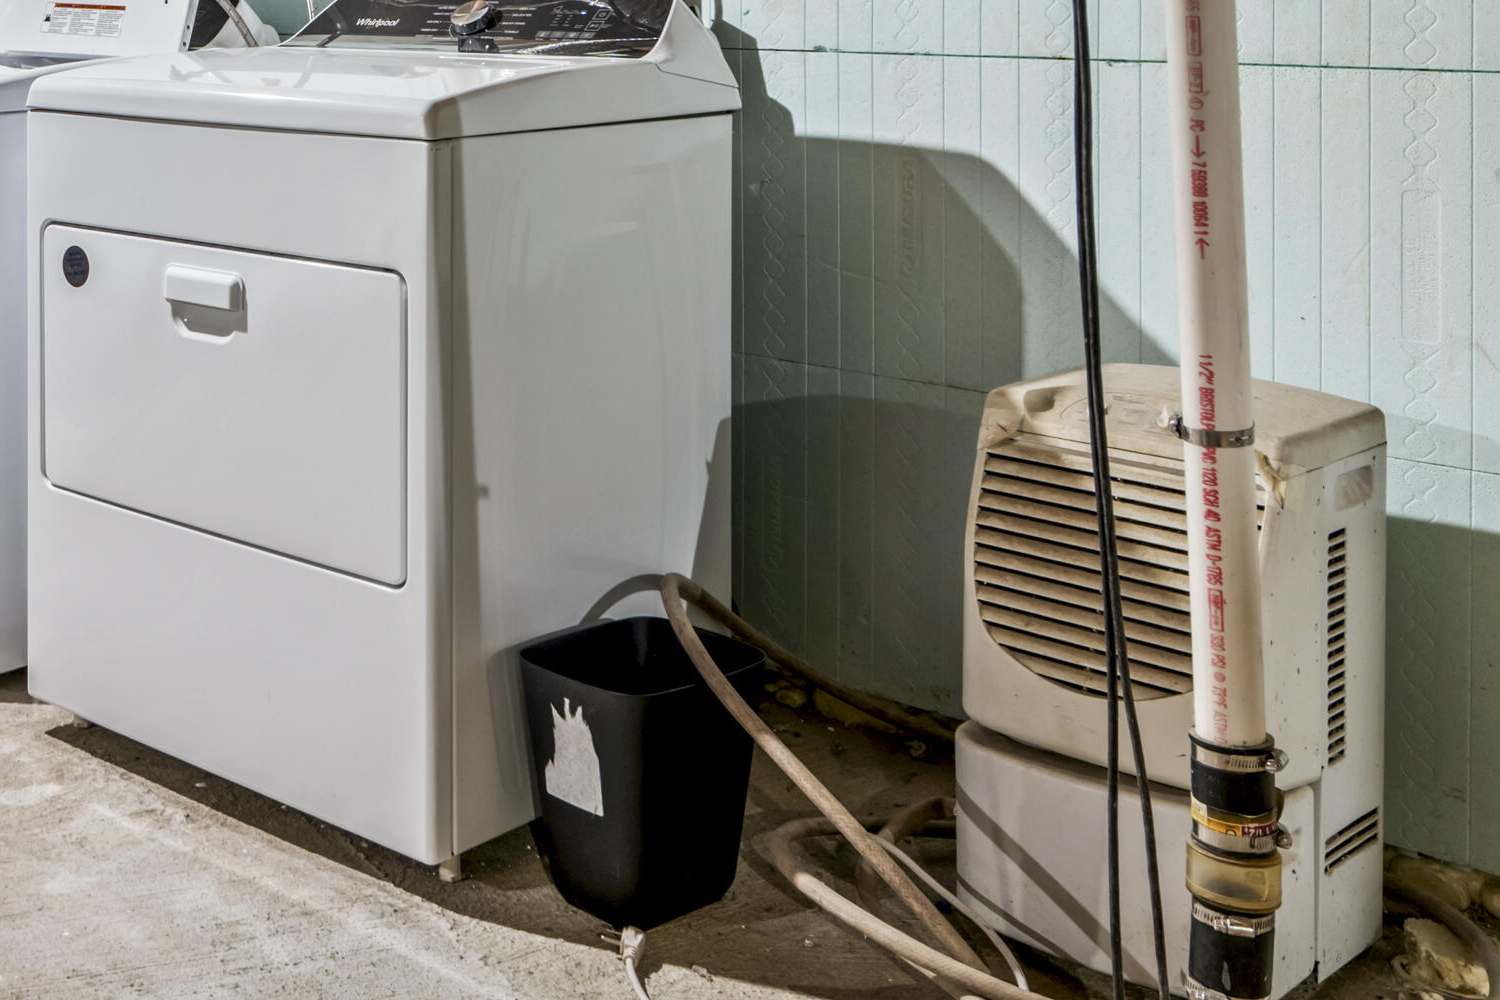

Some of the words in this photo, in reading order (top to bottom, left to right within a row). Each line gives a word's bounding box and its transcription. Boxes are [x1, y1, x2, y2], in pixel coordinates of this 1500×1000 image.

[356, 18, 400, 28] Whirlpool
[1199, 387, 1215, 431] BRISTOLP
[1202, 446, 1217, 464] PVC
[1202, 467, 1218, 486] 1120
[1203, 488, 1219, 506] SCH
[1204, 509, 1220, 521] 40
[1205, 525, 1222, 551] ASTM
[1206, 554, 1223, 585] D-1785
[1209, 633, 1226, 650] 330
[1211, 654, 1226, 668] PSI
[1214, 710, 1228, 732] ASTM
